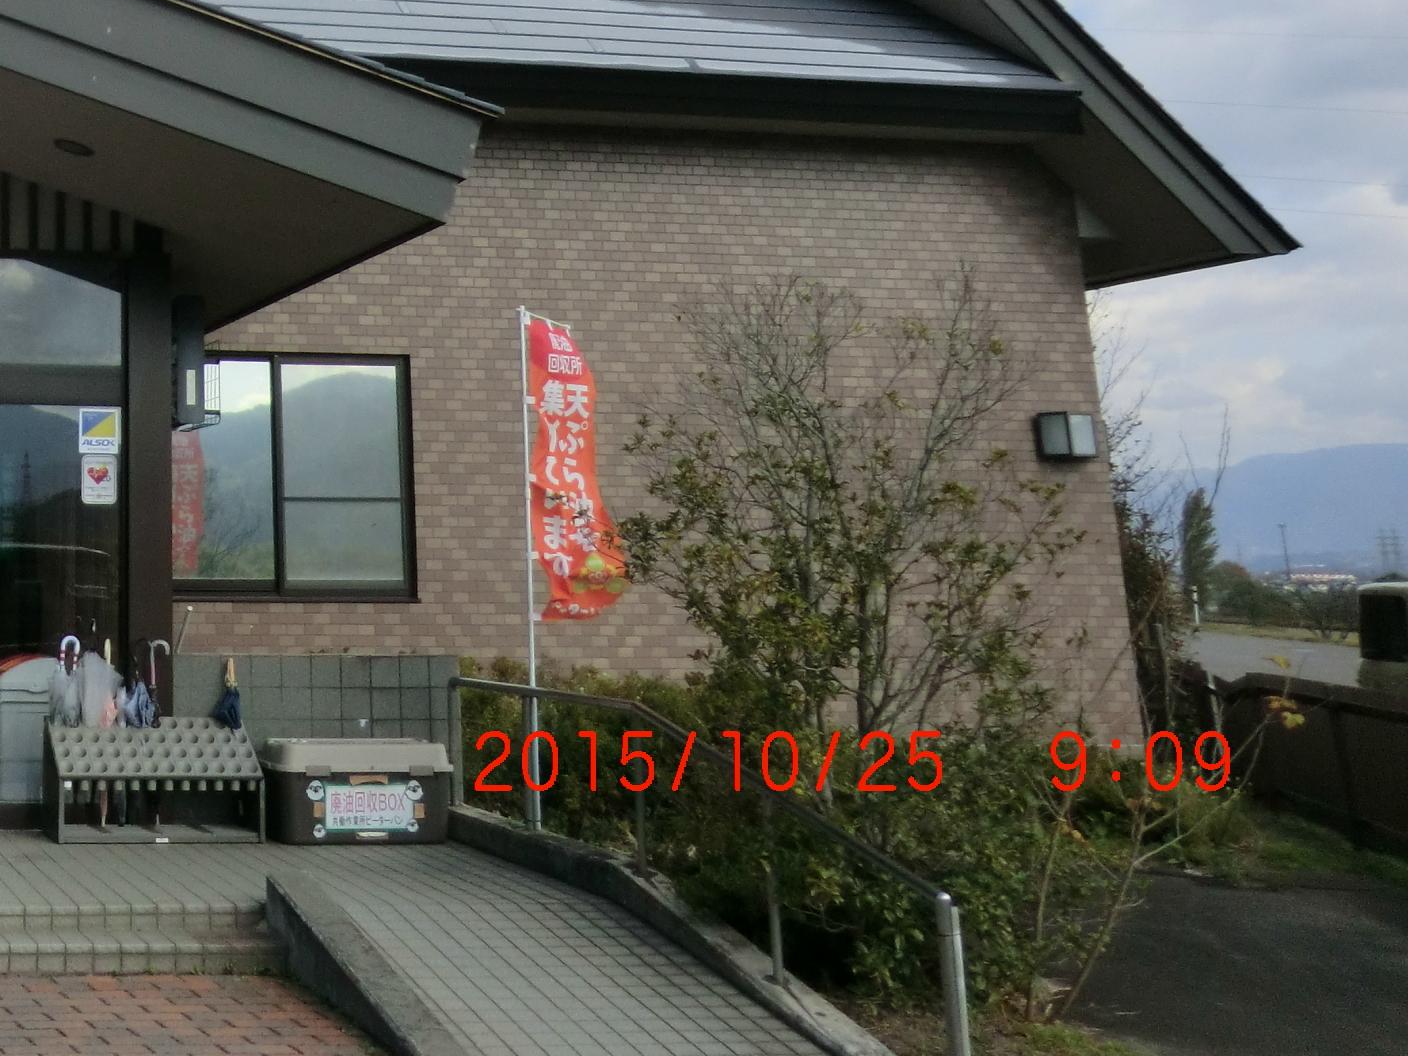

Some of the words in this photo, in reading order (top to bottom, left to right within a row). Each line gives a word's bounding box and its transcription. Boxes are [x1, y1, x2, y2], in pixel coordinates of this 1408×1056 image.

[548, 353, 582, 376] 回収所
[81, 438, 115, 447] ALSOK
[330, 790, 405, 813] 廃油回収BOX
